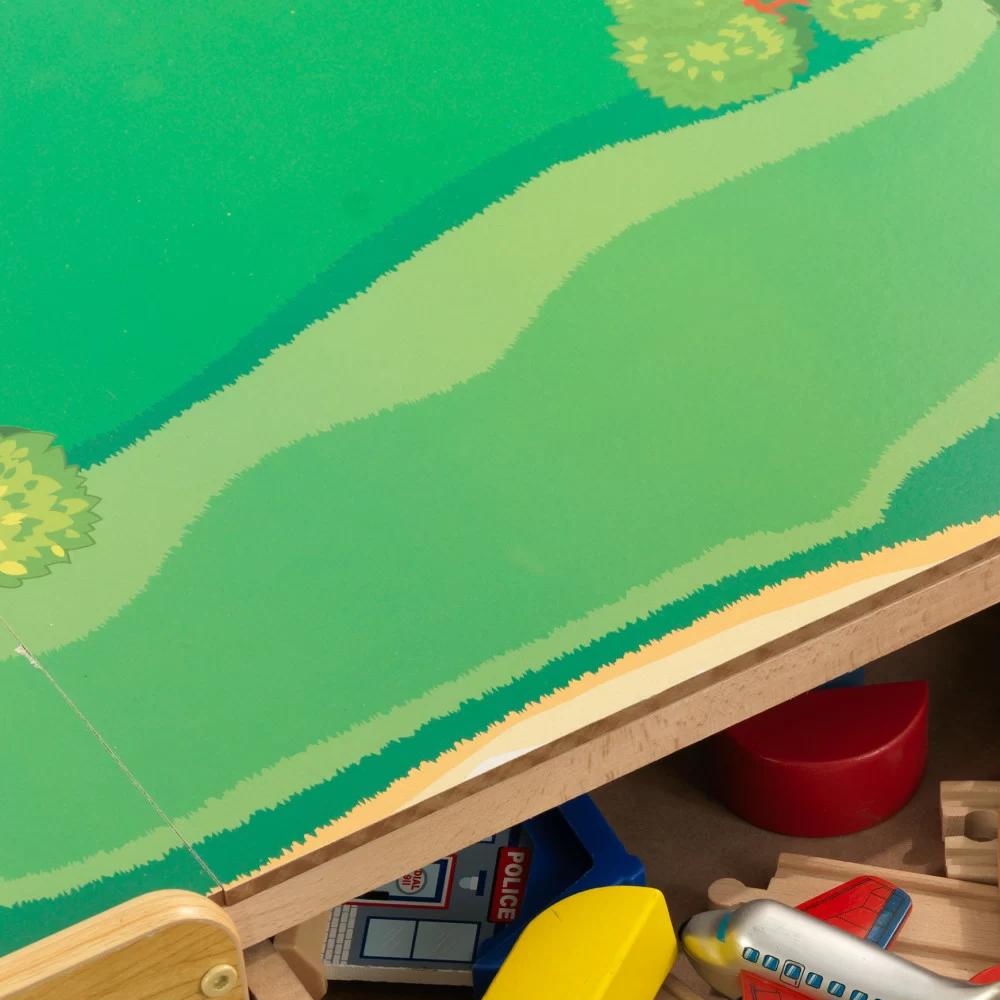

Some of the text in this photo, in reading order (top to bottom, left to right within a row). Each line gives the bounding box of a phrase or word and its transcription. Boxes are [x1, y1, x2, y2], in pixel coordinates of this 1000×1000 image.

[402, 874, 412, 886] 911
[411, 870, 423, 890] DIAL
[497, 852, 525, 919] POLICE
